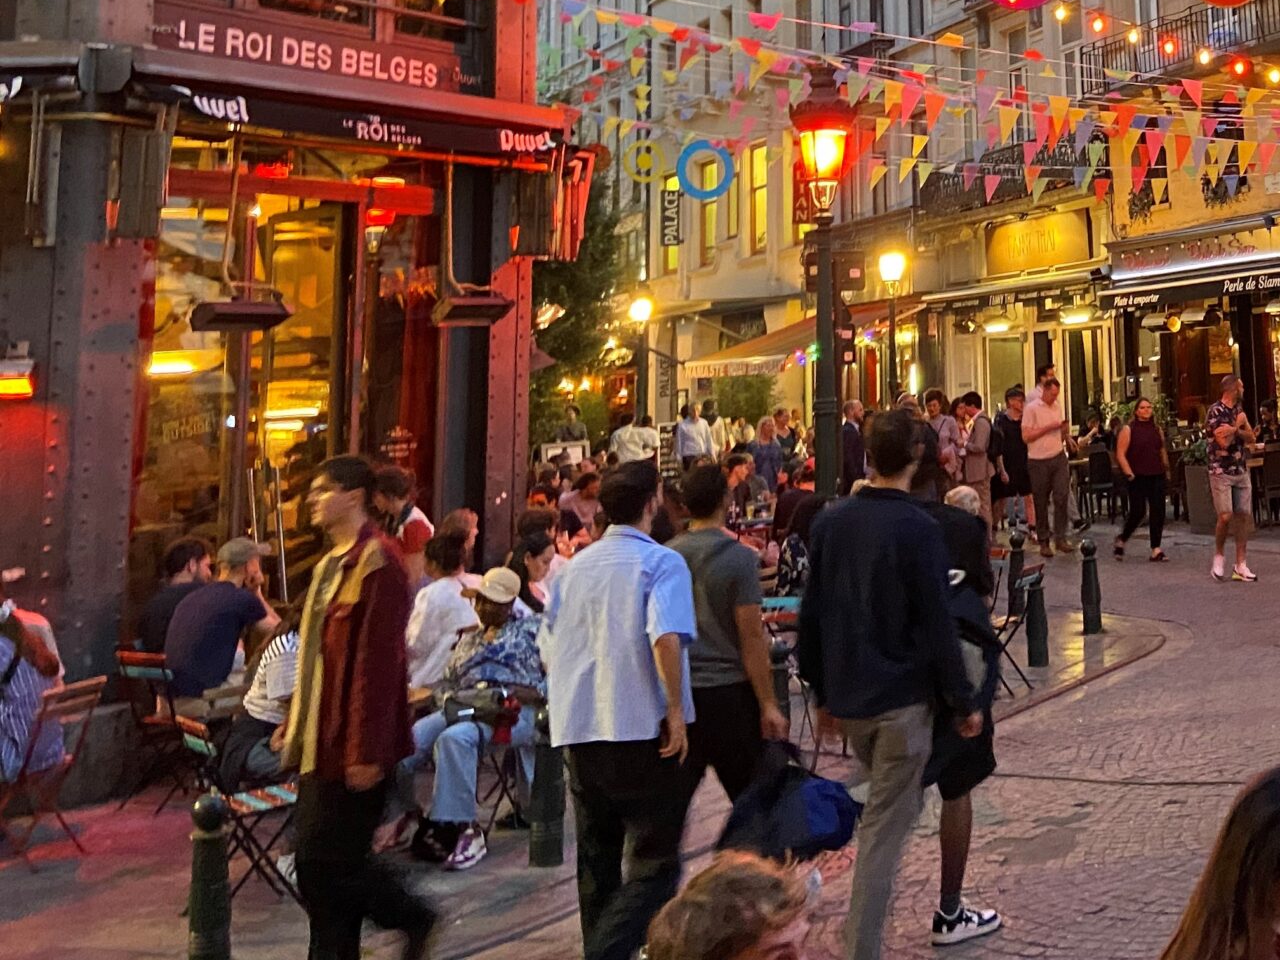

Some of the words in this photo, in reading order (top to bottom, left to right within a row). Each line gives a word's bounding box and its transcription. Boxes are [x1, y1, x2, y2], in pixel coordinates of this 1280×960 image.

[178, 19, 216, 54] LE
[225, 28, 272, 61] ROI
[281, 37, 333, 71] DES
[340, 47, 437, 88] BELGES
[356, 120, 388, 143] ROI
[500, 128, 556, 152] Duvel
[663, 191, 678, 245] PALACE
[1223, 279, 1244, 293] Perle
[1245, 277, 1256, 290] de
[1258, 275, 1280, 289] Siam
